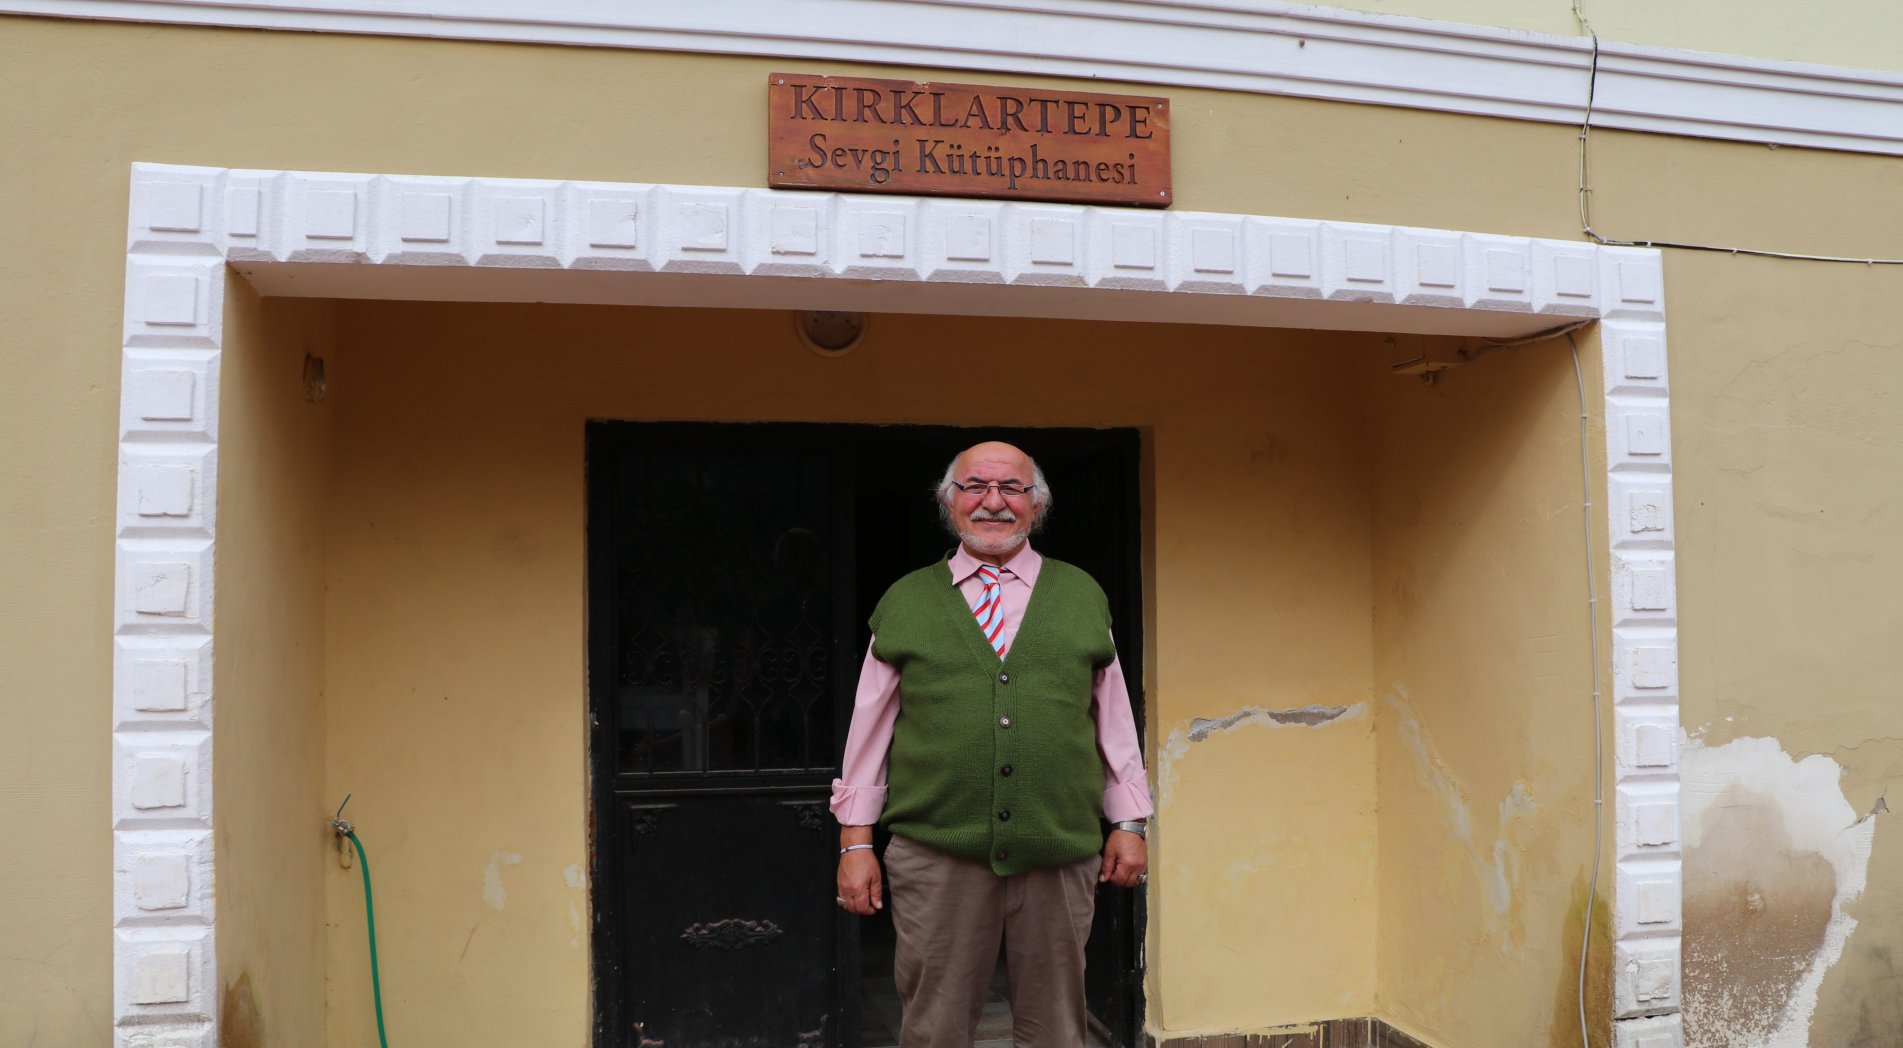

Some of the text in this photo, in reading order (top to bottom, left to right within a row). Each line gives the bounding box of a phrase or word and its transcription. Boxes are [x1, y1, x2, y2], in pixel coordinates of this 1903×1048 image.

[790, 84, 1154, 139] KIRKLARTEPE
[807, 133, 1138, 190] Sevgi Kütüphanesi
